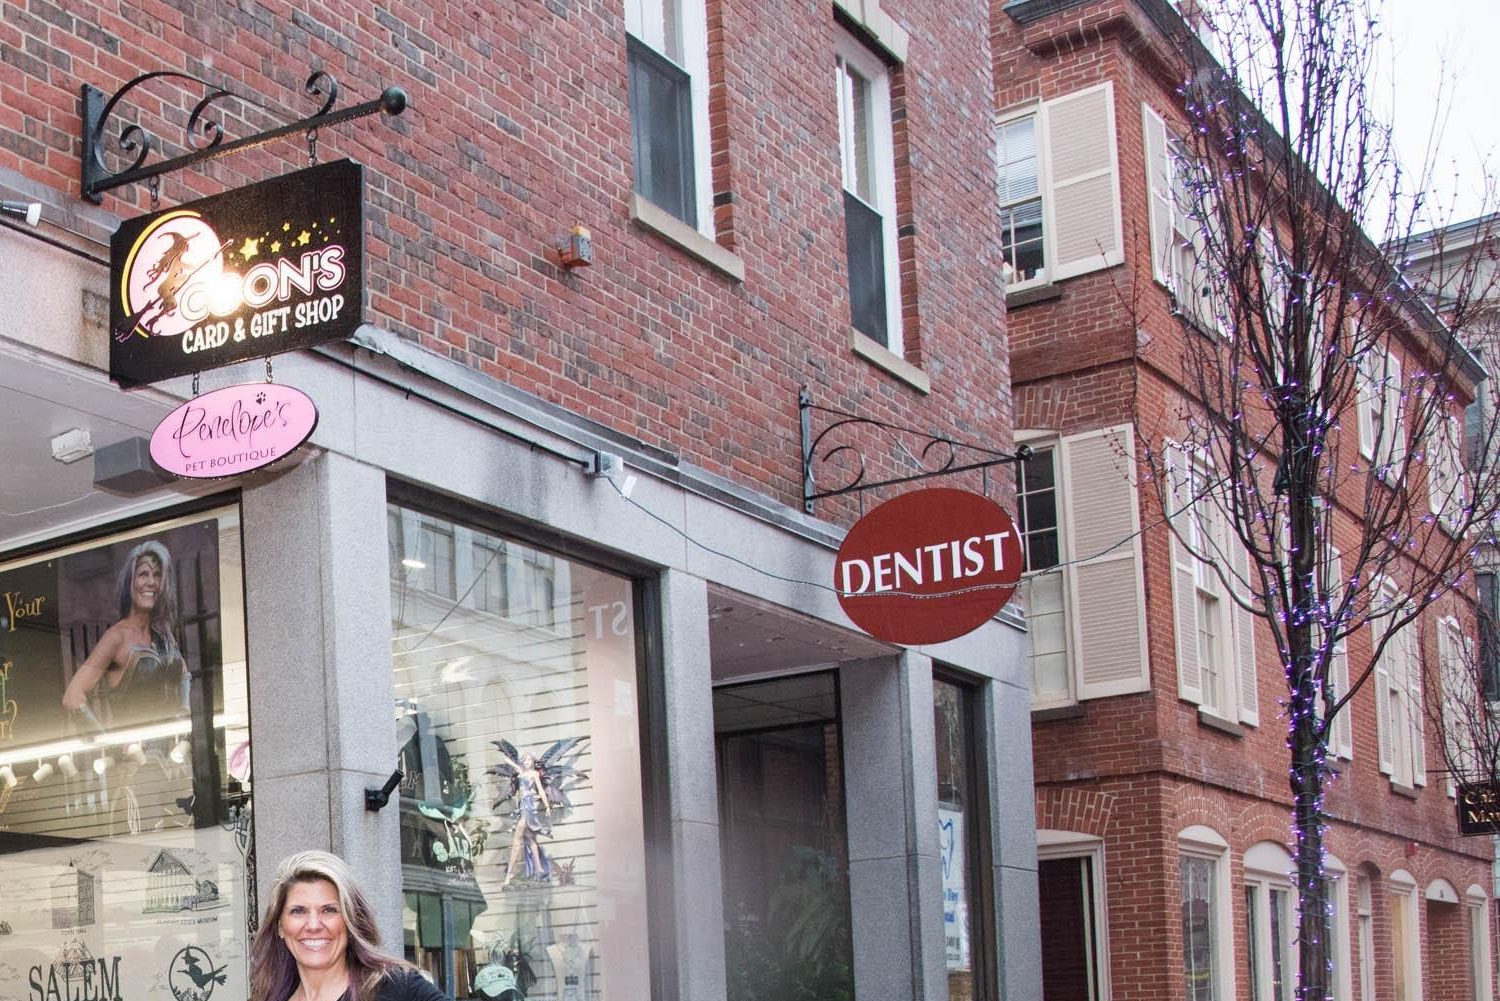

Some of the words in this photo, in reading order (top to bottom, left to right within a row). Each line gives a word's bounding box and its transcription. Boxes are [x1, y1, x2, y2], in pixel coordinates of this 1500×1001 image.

[180, 245, 345, 322] CON'S
[182, 323, 227, 353] CARD
[234, 320, 246, 342] &
[251, 307, 290, 338] GIFT
[296, 295, 344, 328] SHOP
[173, 400, 290, 458] Penelope's
[186, 461, 206, 472] PET
[210, 447, 276, 468] BOUTIQUE
[841, 531, 1010, 598] DENTIST
[3, 591, 45, 632] Your
